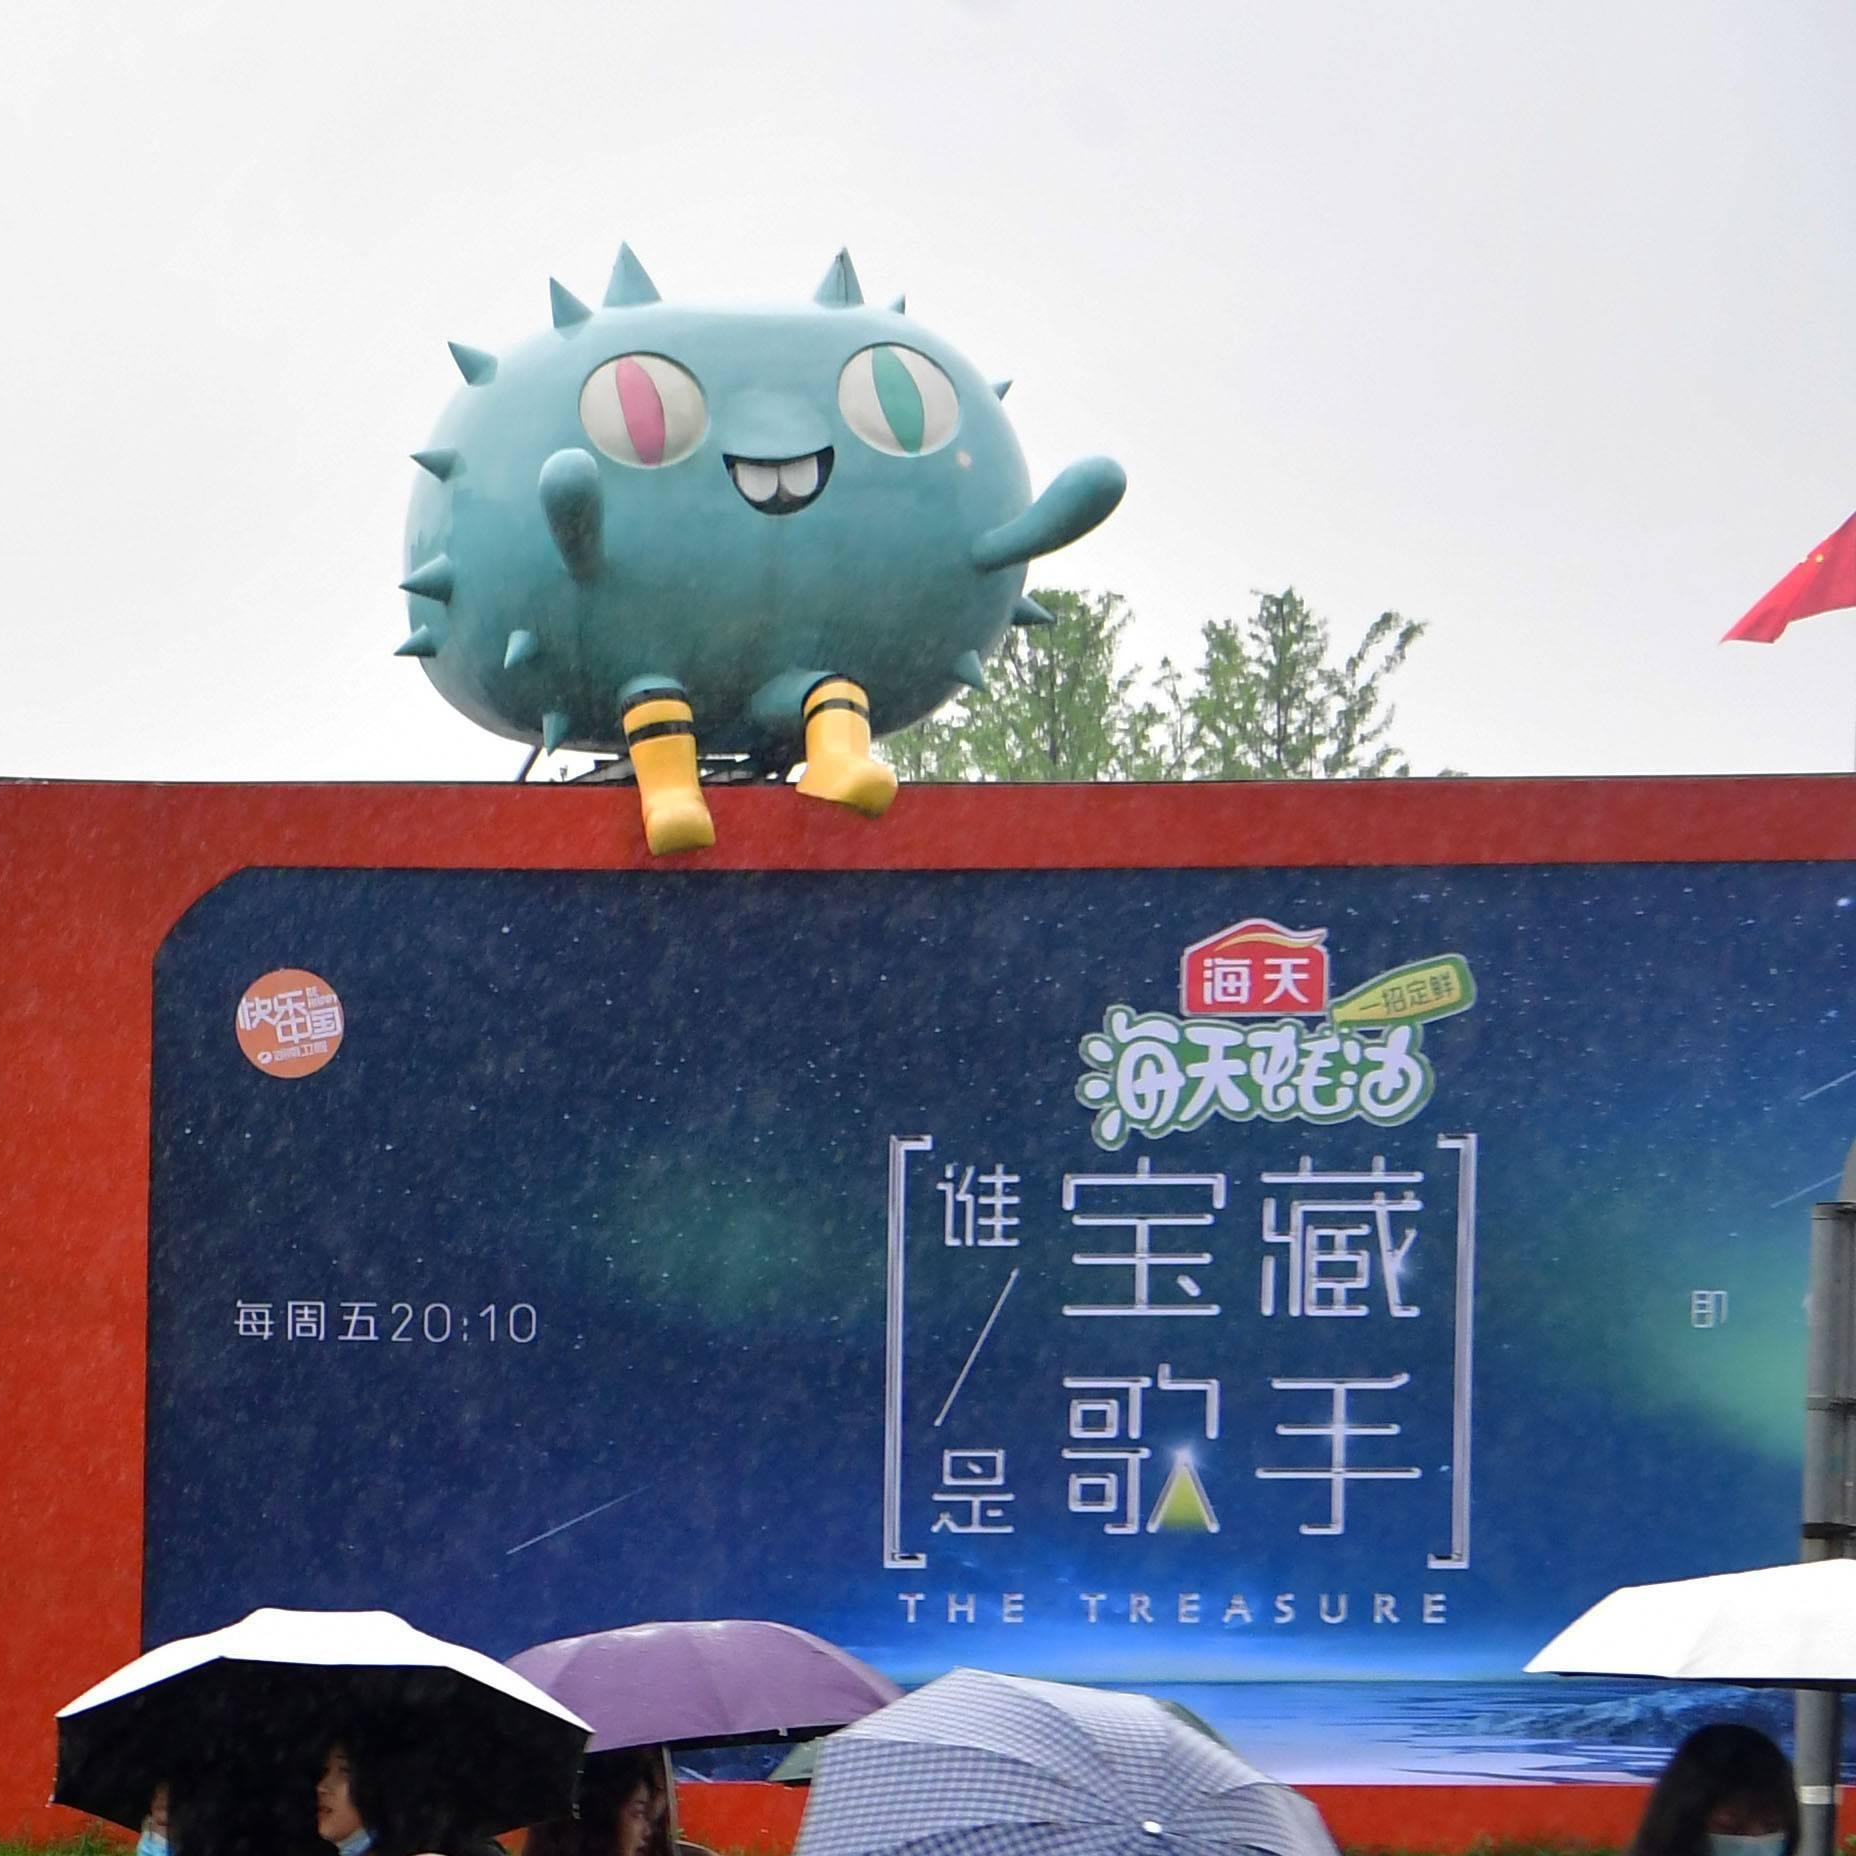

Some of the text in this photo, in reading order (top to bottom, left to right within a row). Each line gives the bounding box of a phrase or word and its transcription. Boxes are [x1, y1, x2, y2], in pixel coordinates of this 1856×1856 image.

[1203, 957, 1310, 1005] 海天
[1358, 971, 1458, 1014] 一招定鲜
[1083, 1010, 1424, 1142] 海天蚝油
[1061, 1155, 1424, 1317] 宝藏
[1061, 1363, 1422, 1535] 歌手
[899, 1593, 1448, 1624] THE TREASURE
